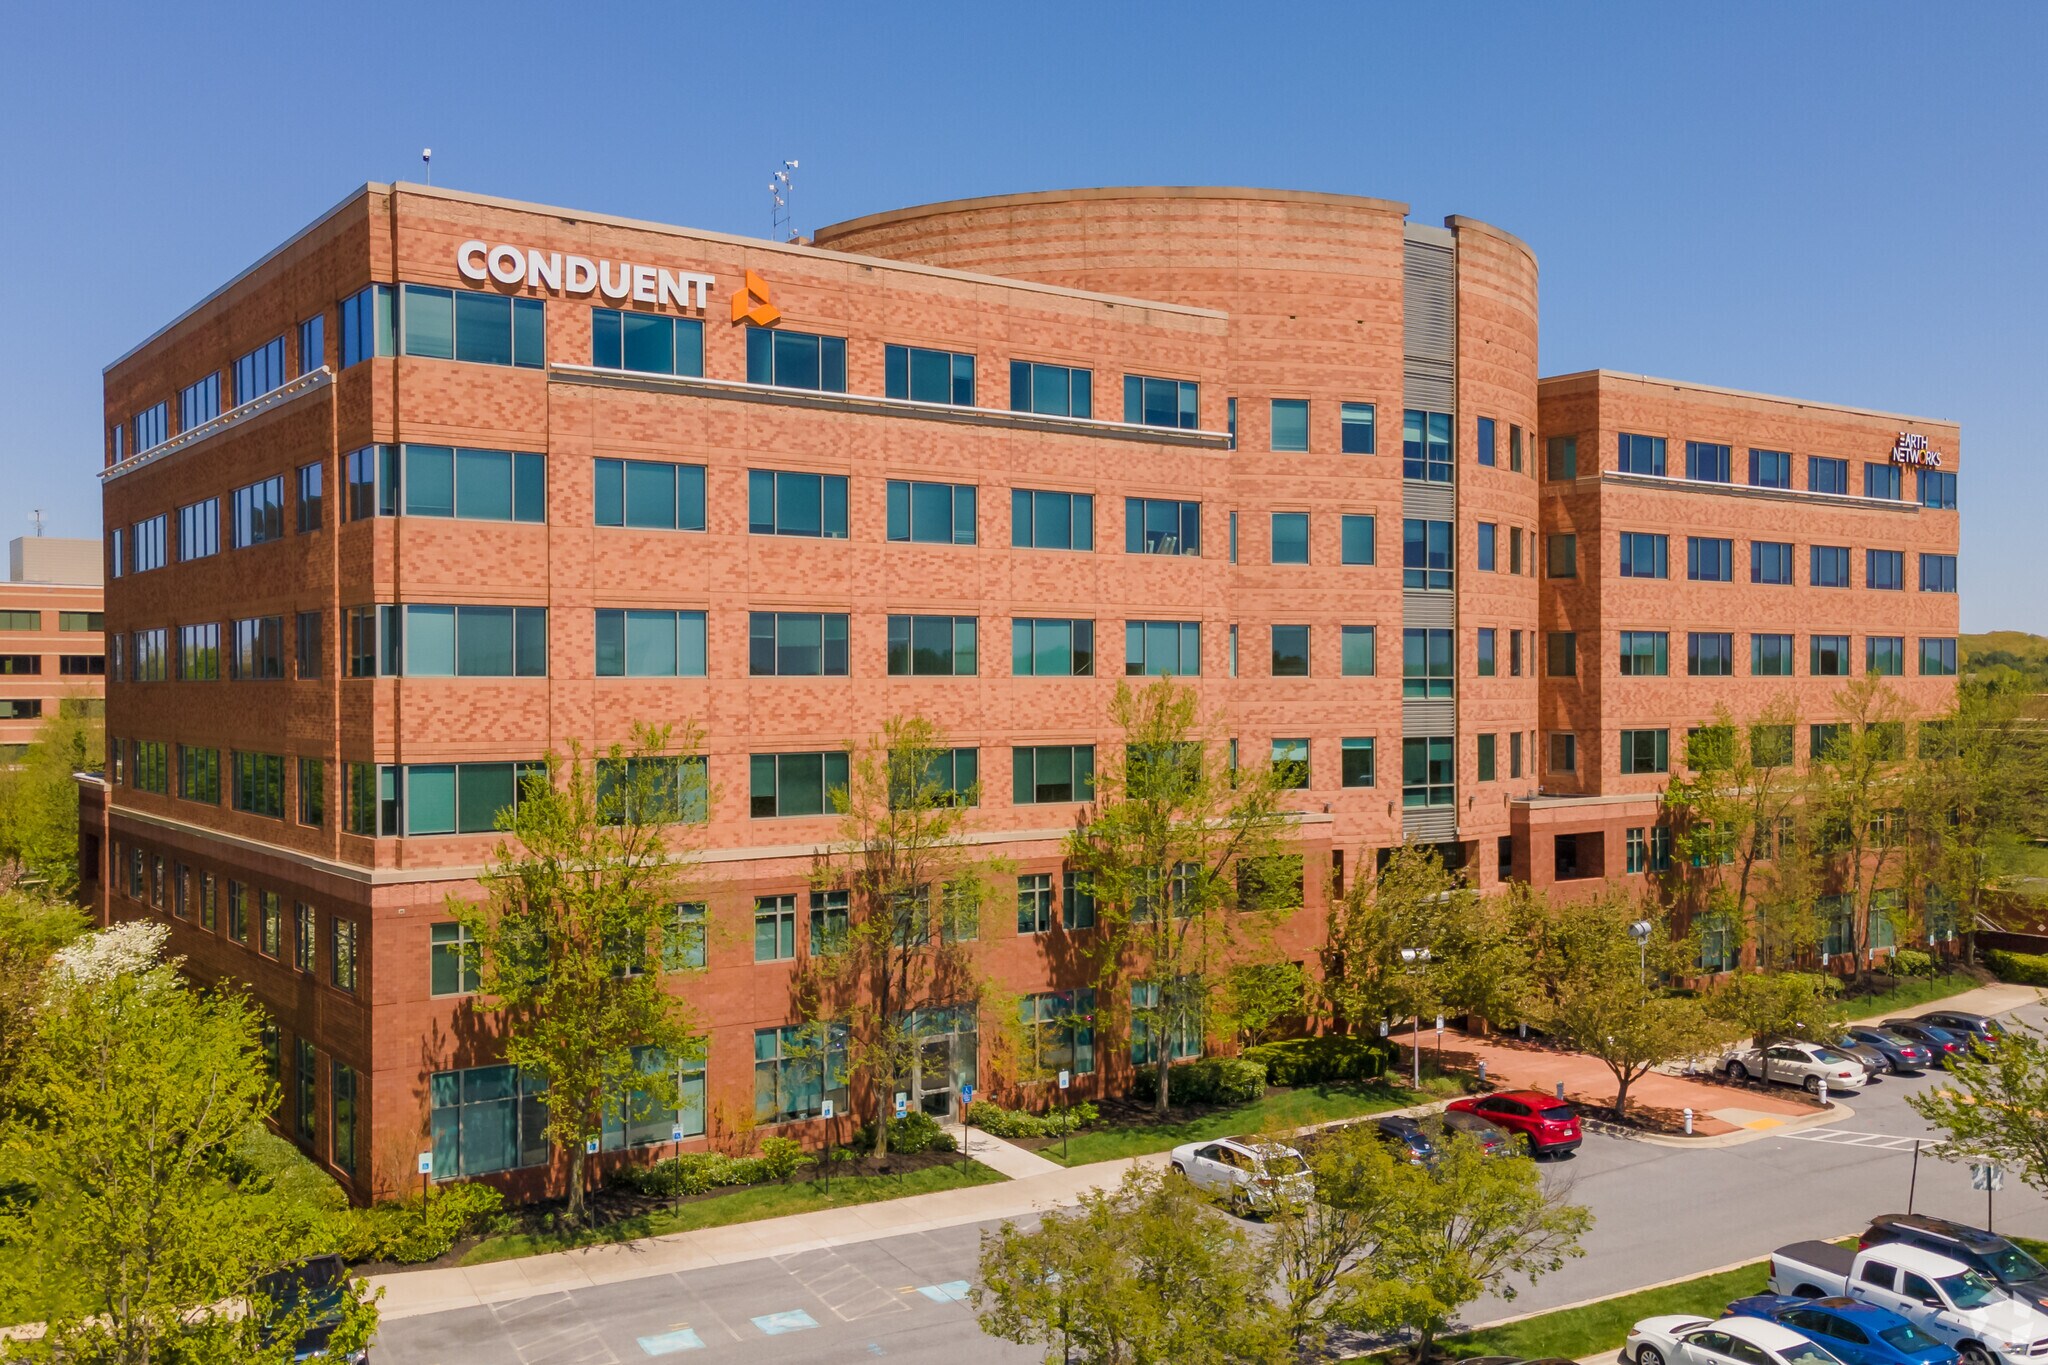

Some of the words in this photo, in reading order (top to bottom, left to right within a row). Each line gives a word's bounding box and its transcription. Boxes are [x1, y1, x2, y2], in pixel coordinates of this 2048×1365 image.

[457, 240, 715, 308] CONDUENT
[1899, 432, 1928, 449] EARTH
[1893, 447, 1942, 466] NETWORKS
